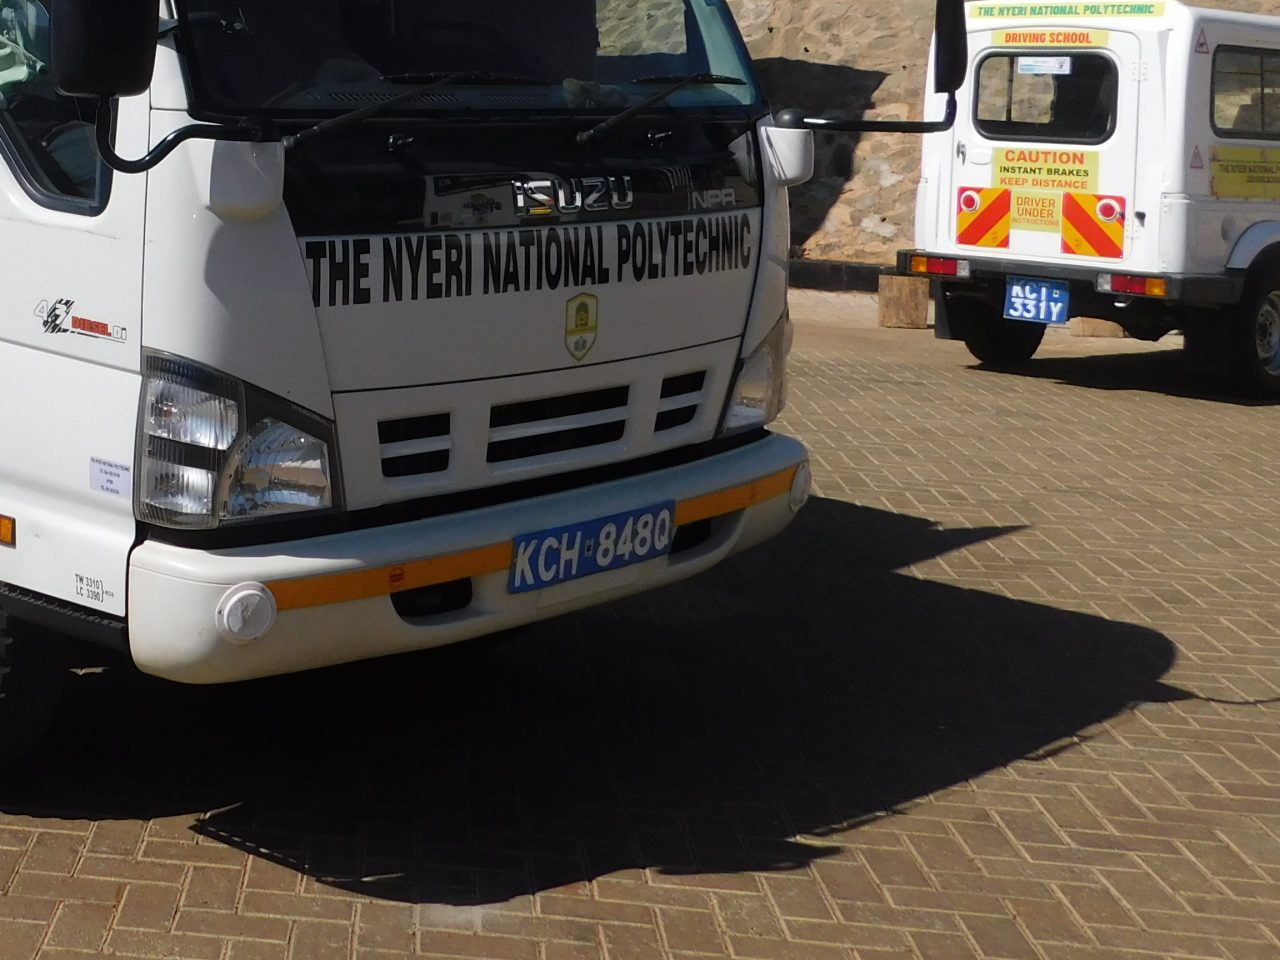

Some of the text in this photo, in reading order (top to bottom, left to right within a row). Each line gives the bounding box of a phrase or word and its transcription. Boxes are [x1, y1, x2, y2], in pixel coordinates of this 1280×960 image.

[978, 3, 1155, 17] THE NYERI NATIONAL POLYTECHNIC
[1004, 31, 1093, 44] DRIVING SCHOOL
[1004, 149, 1085, 165] CAUTION
[999, 165, 1089, 178] INSTANT BRAKES
[1000, 176, 1088, 189] KEEP DISTANCE
[513, 176, 634, 216] ISUZU
[691, 187, 736, 210] NPR
[1016, 196, 1056, 208] DRIVER
[1017, 207, 1054, 218] UNDER
[305, 212, 752, 308] THE NYERI NATIONAL POLYTECHNIC
[1008, 298, 1063, 321] 331Y
[71, 315, 112, 337] DIESEL
[513, 508, 672, 588] KCH 848Q
[74, 573, 100, 590] TW 3310
[75, 584, 101, 602] LC 3390
